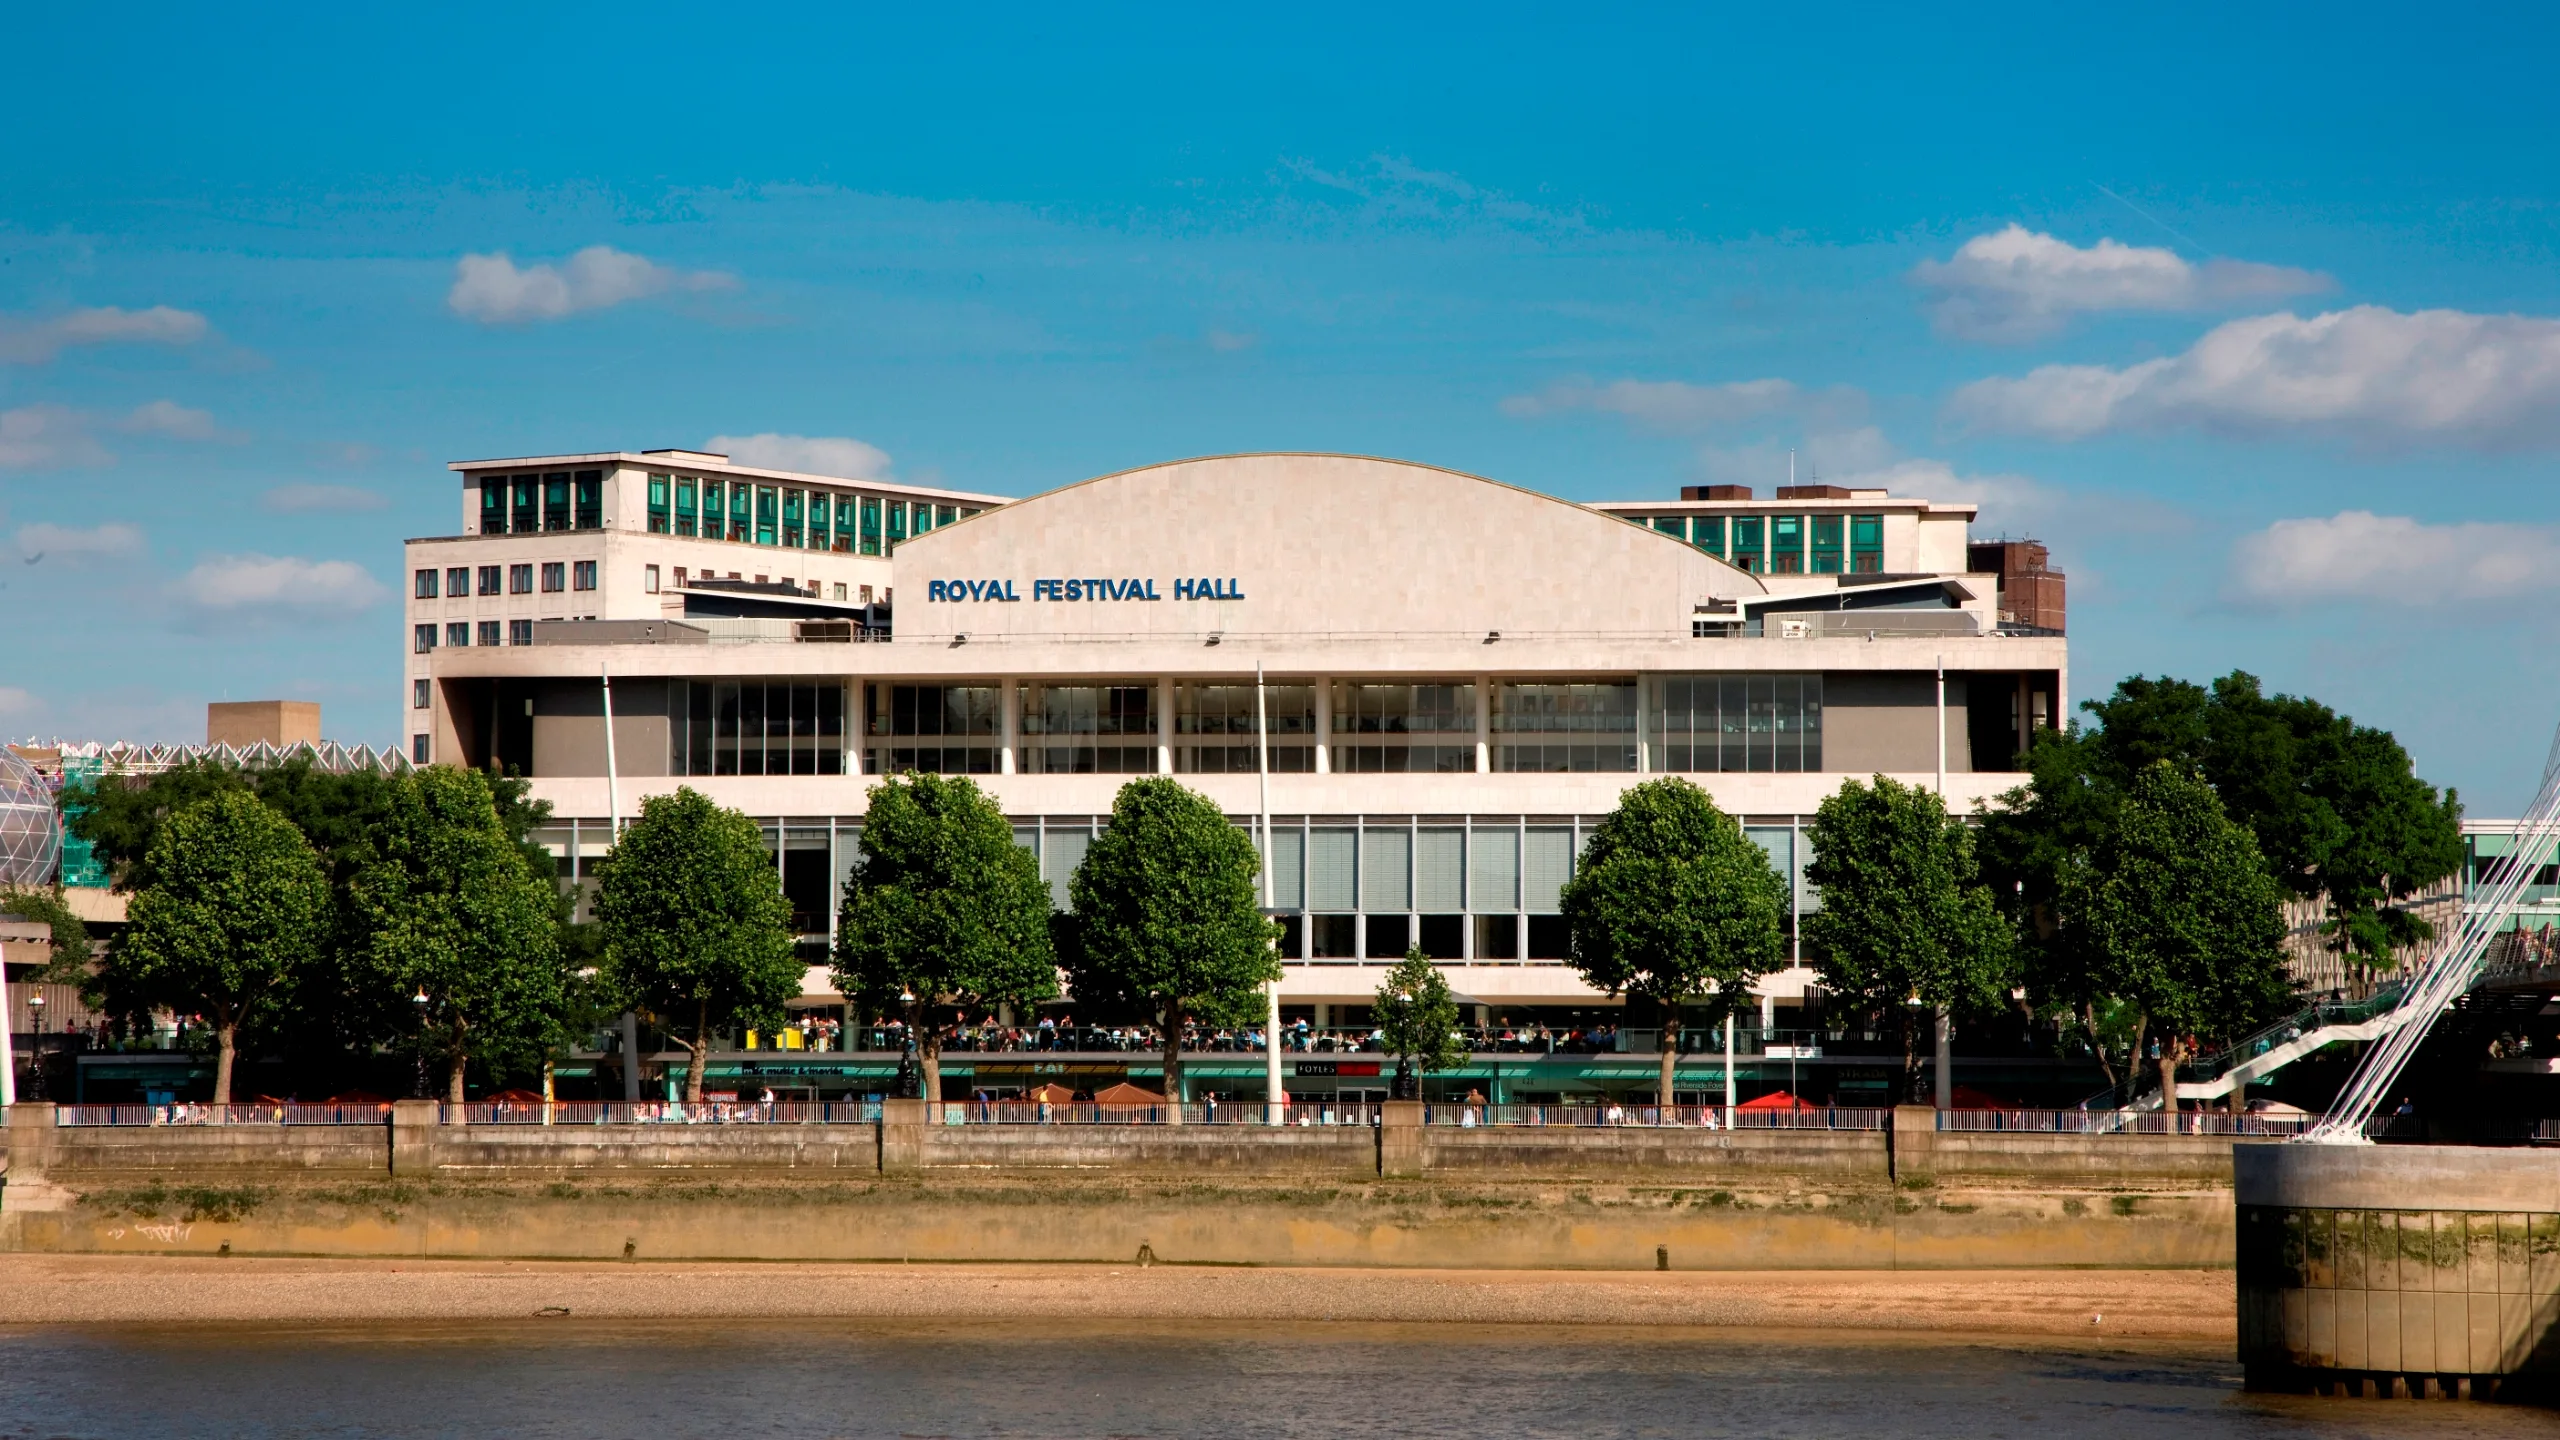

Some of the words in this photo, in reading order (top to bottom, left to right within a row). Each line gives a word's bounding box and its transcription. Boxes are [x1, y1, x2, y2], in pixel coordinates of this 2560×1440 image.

[929, 580, 1020, 602] ROYAL
[1034, 579, 1161, 601] FESTIVAL
[1175, 578, 1245, 600] HALL
[767, 1066, 795, 1075] music
[808, 1066, 844, 1075] movies
[1299, 1064, 1335, 1073] FOYLES
[1837, 1068, 1888, 1079] STRADA
[1680, 1081, 1707, 1089] Riverside
[1708, 1081, 1724, 1090] Foyer
